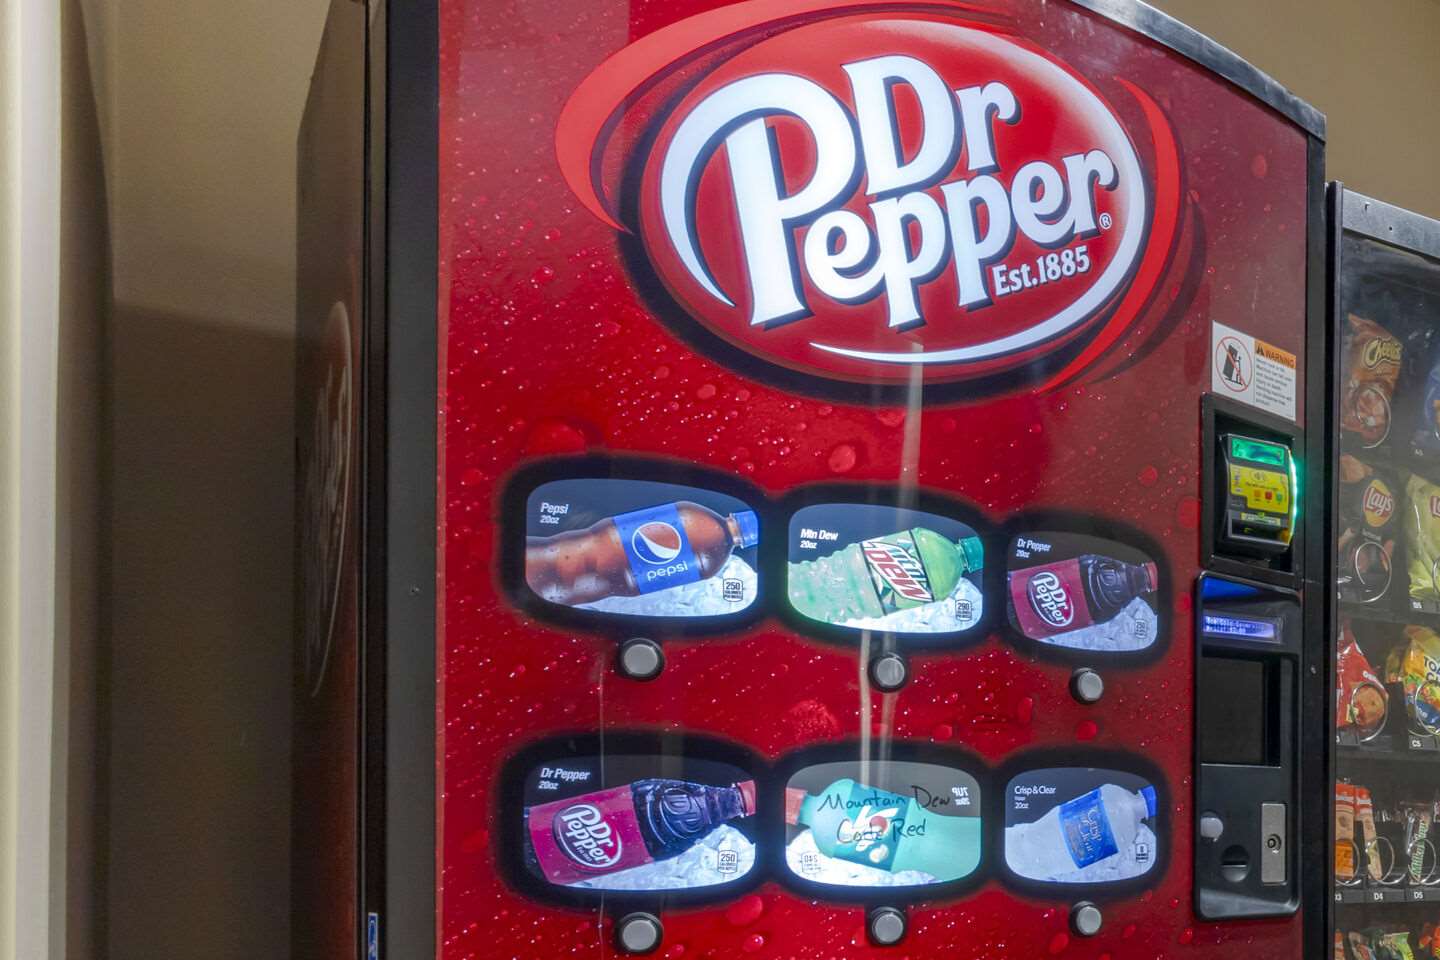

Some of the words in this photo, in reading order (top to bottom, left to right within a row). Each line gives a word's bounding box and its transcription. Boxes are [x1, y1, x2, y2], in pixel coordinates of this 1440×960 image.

[842, 54, 1018, 195] Dr
[660, 71, 1115, 329] Pepper
[993, 246, 1090, 297] Est.1885
[1265, 349, 1296, 370] WARNING
[540, 502, 568, 515] Pepsi
[540, 515, 560, 524] 20oz
[800, 528, 818, 539] Mtn
[819, 530, 838, 541] Dew
[800, 541, 817, 549] 20oz
[1017, 538, 1026, 548] Dr
[1027, 540, 1051, 552] Pepper
[647, 561, 688, 581] pepsi
[726, 582, 741, 591] 250
[1031, 571, 1067, 623] Pepper
[1050, 586, 1068, 611] Dr
[540, 768, 553, 778] Dr
[554, 768, 590, 781] Pepper
[538, 781, 558, 790] 20oz
[817, 790, 906, 812] Mountain
[912, 785, 951, 811] Dew
[561, 805, 611, 865] Pepper
[591, 820, 614, 848] Dr
[837, 818, 883, 844] Code
[892, 818, 927, 842] Red
[721, 853, 736, 862] 250
[1373, 892, 1384, 902] D4
[1414, 891, 1424, 900] D5
